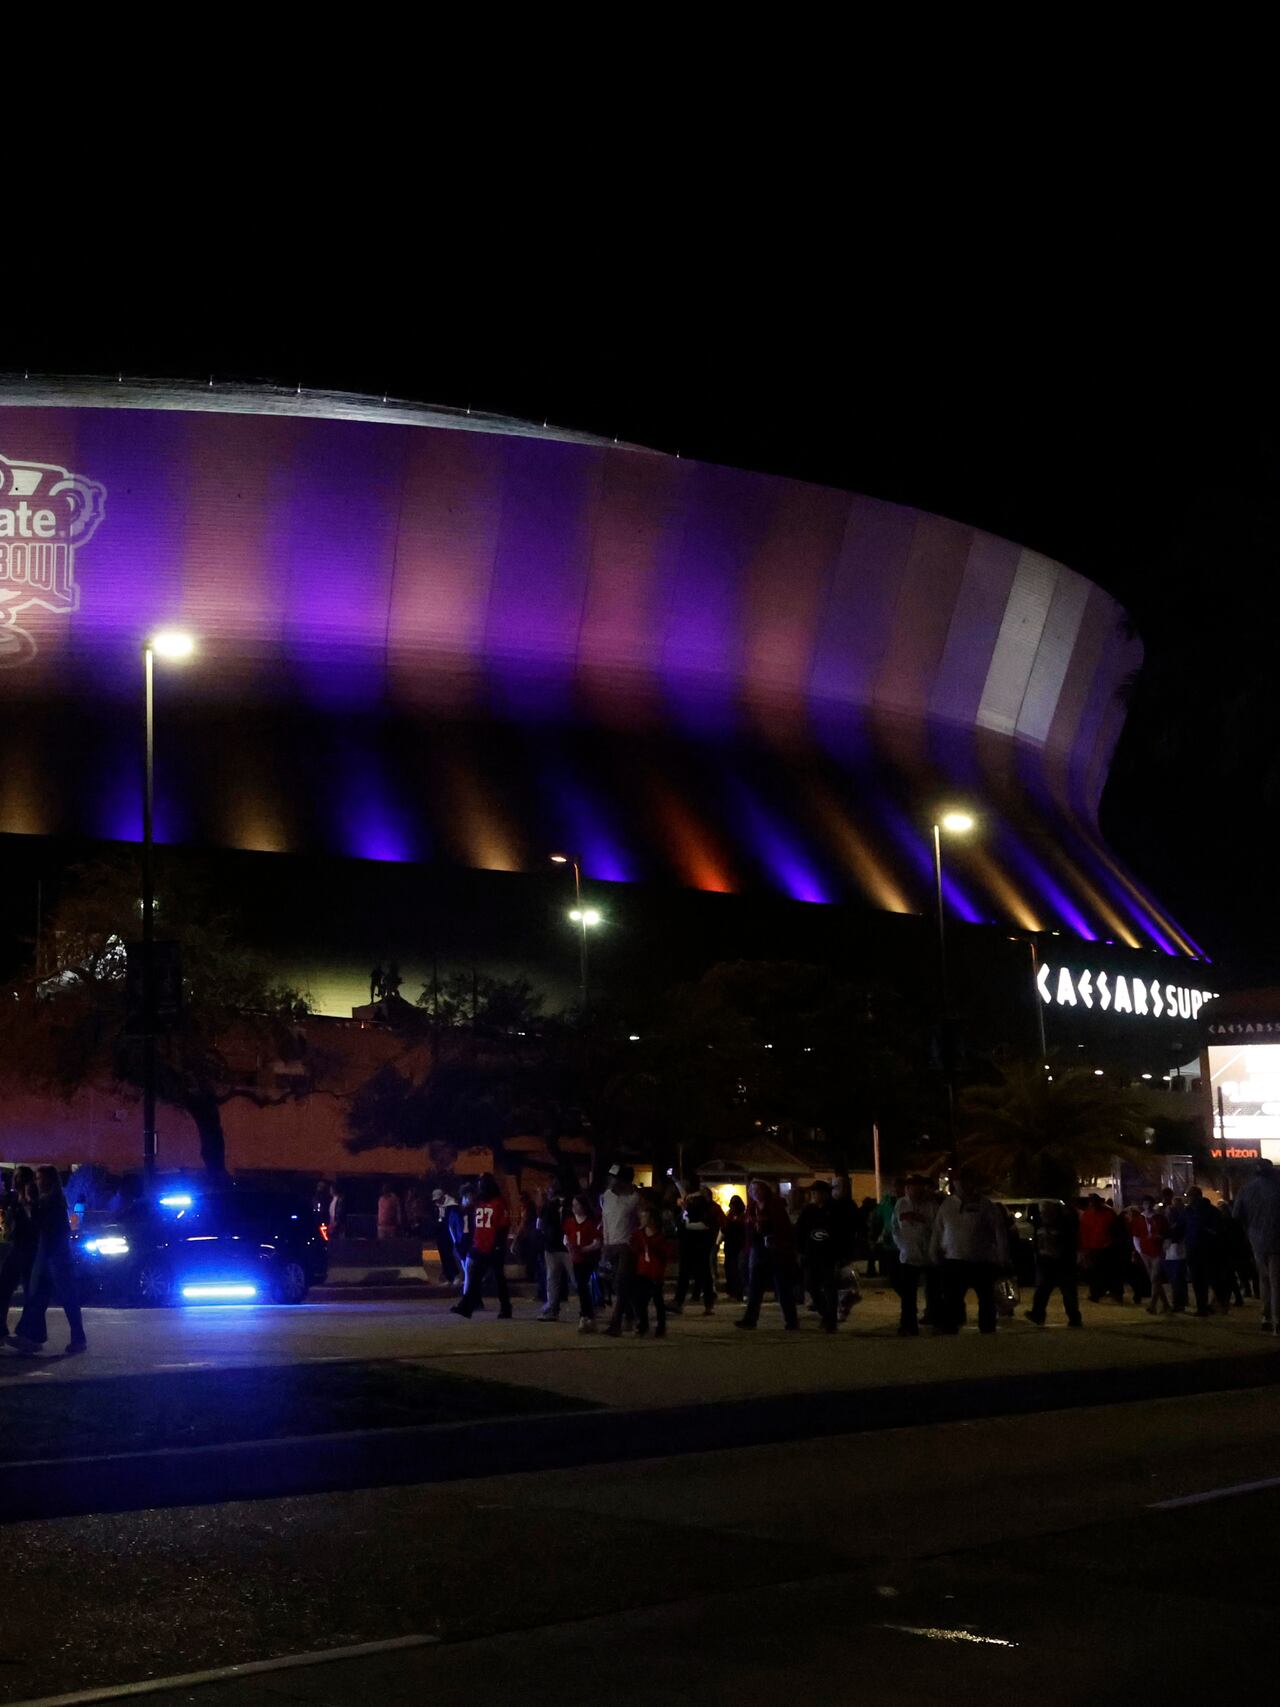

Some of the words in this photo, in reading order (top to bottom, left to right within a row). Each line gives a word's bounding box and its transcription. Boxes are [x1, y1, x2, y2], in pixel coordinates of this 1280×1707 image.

[1037, 963, 1164, 1018] CAESARS
[1166, 984, 1220, 1020] SUP
[475, 1207, 494, 1228] 27
